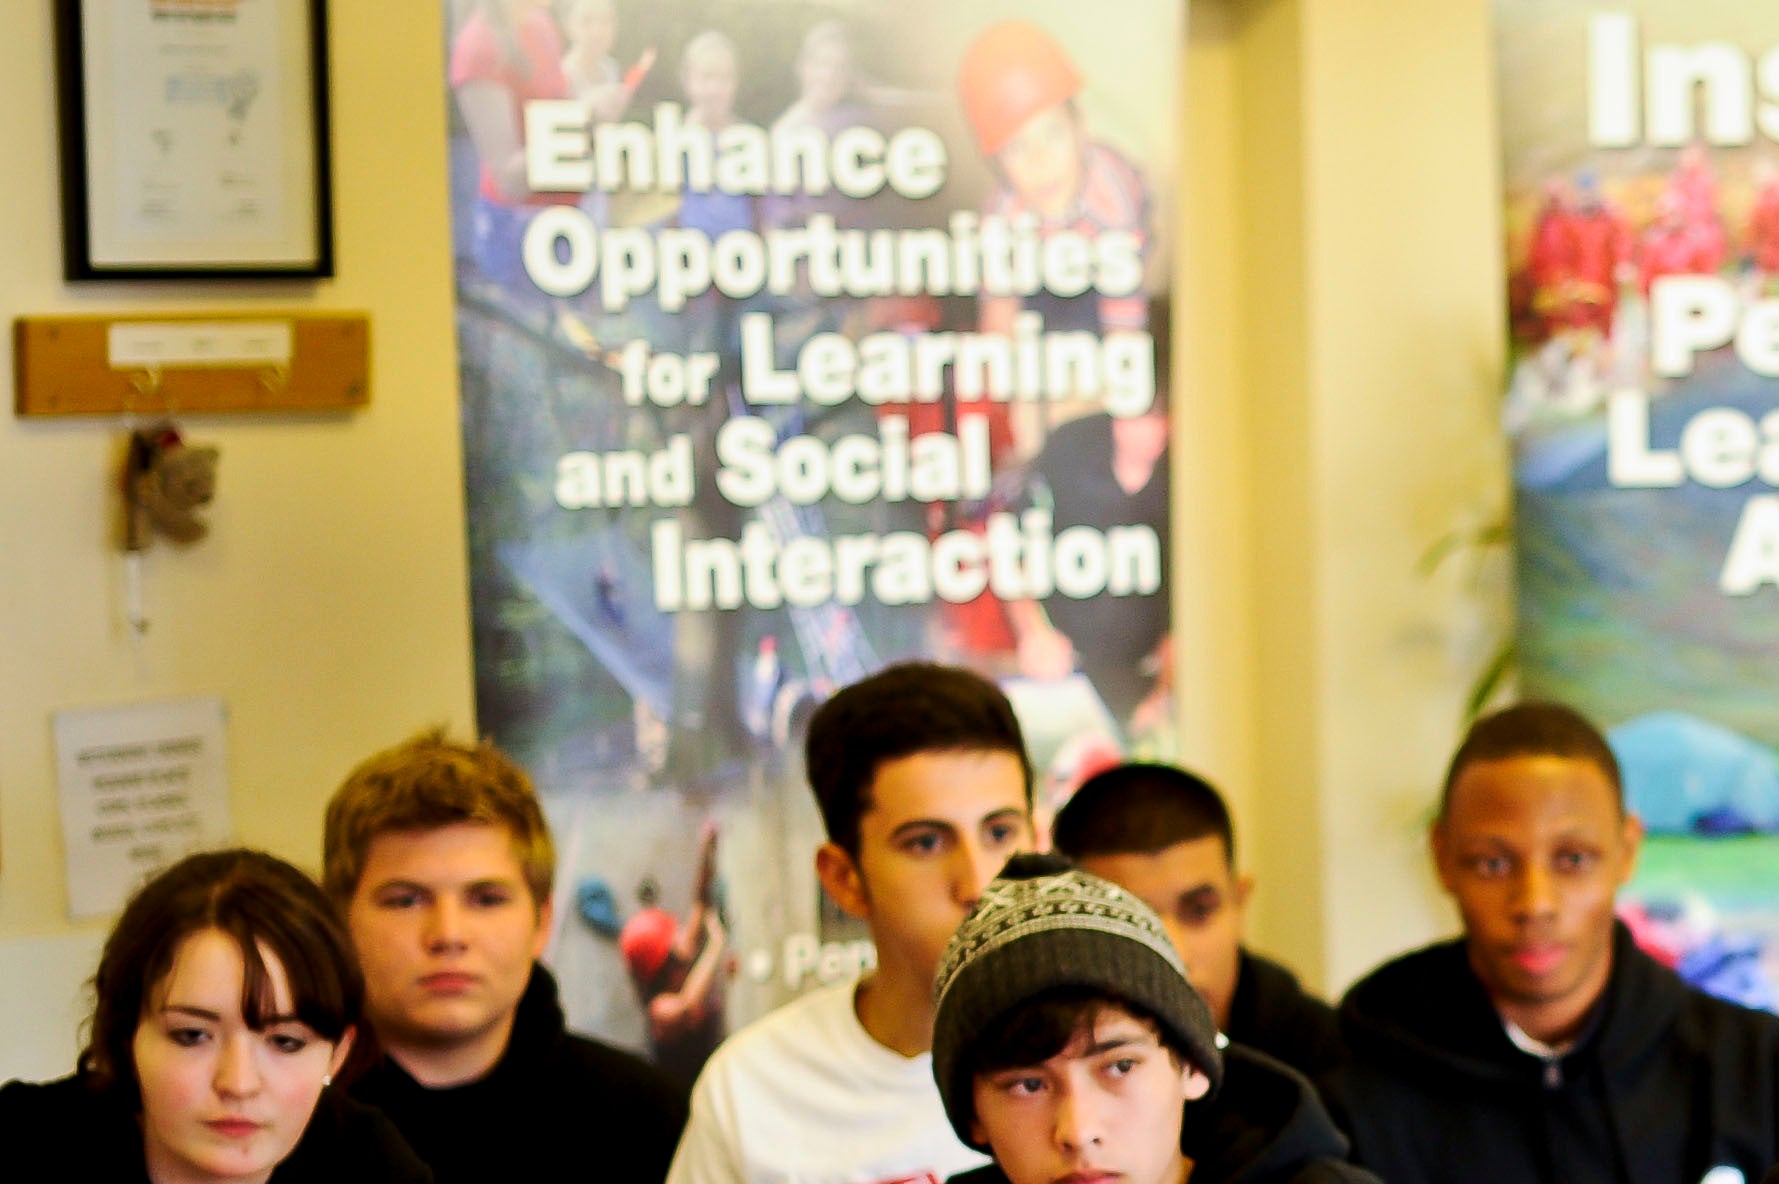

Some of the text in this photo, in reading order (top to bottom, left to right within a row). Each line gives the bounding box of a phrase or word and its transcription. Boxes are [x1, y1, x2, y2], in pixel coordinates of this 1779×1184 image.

[524, 101, 946, 198] Enhance
[522, 205, 1145, 311] Opportunities
[618, 312, 1157, 418] for Learning
[555, 414, 992, 508] and Social
[651, 509, 1162, 612] Interaction
